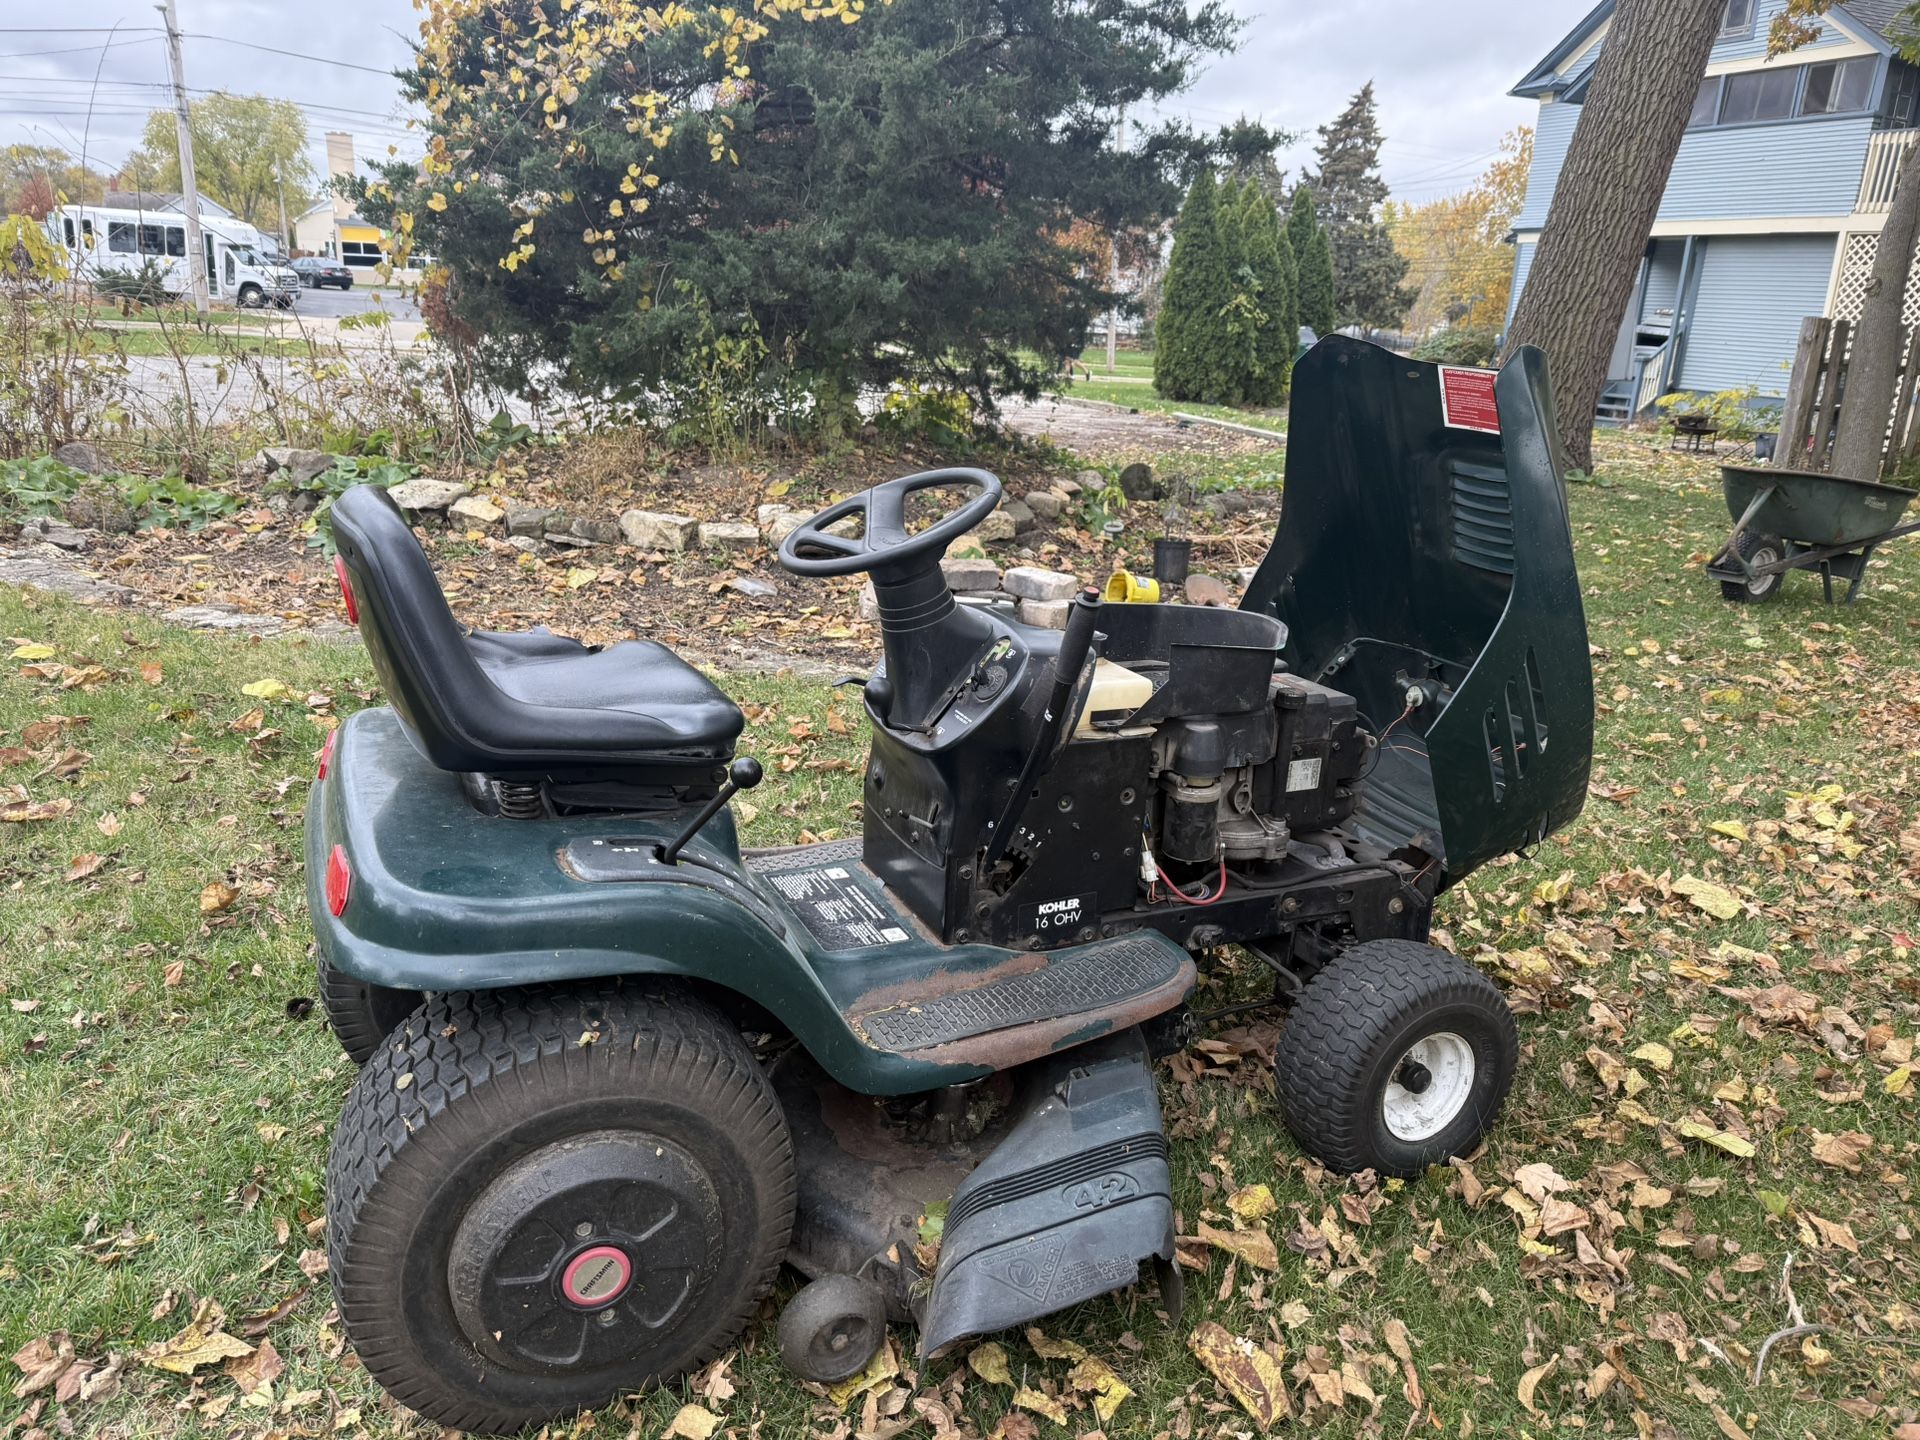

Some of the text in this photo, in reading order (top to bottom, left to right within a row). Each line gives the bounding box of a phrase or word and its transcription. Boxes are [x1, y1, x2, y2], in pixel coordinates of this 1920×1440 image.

[987, 820, 994, 829] 6
[1019, 826, 1027, 835] 3
[1027, 832, 1036, 841] 2
[1038, 898, 1080, 915] KOHLER
[1035, 909, 1082, 929] 16 OHV
[1075, 1174, 1135, 1208] 42
[580, 1258, 616, 1296] CRAFTSMAN
[1033, 1246, 1061, 1299] DANGER
